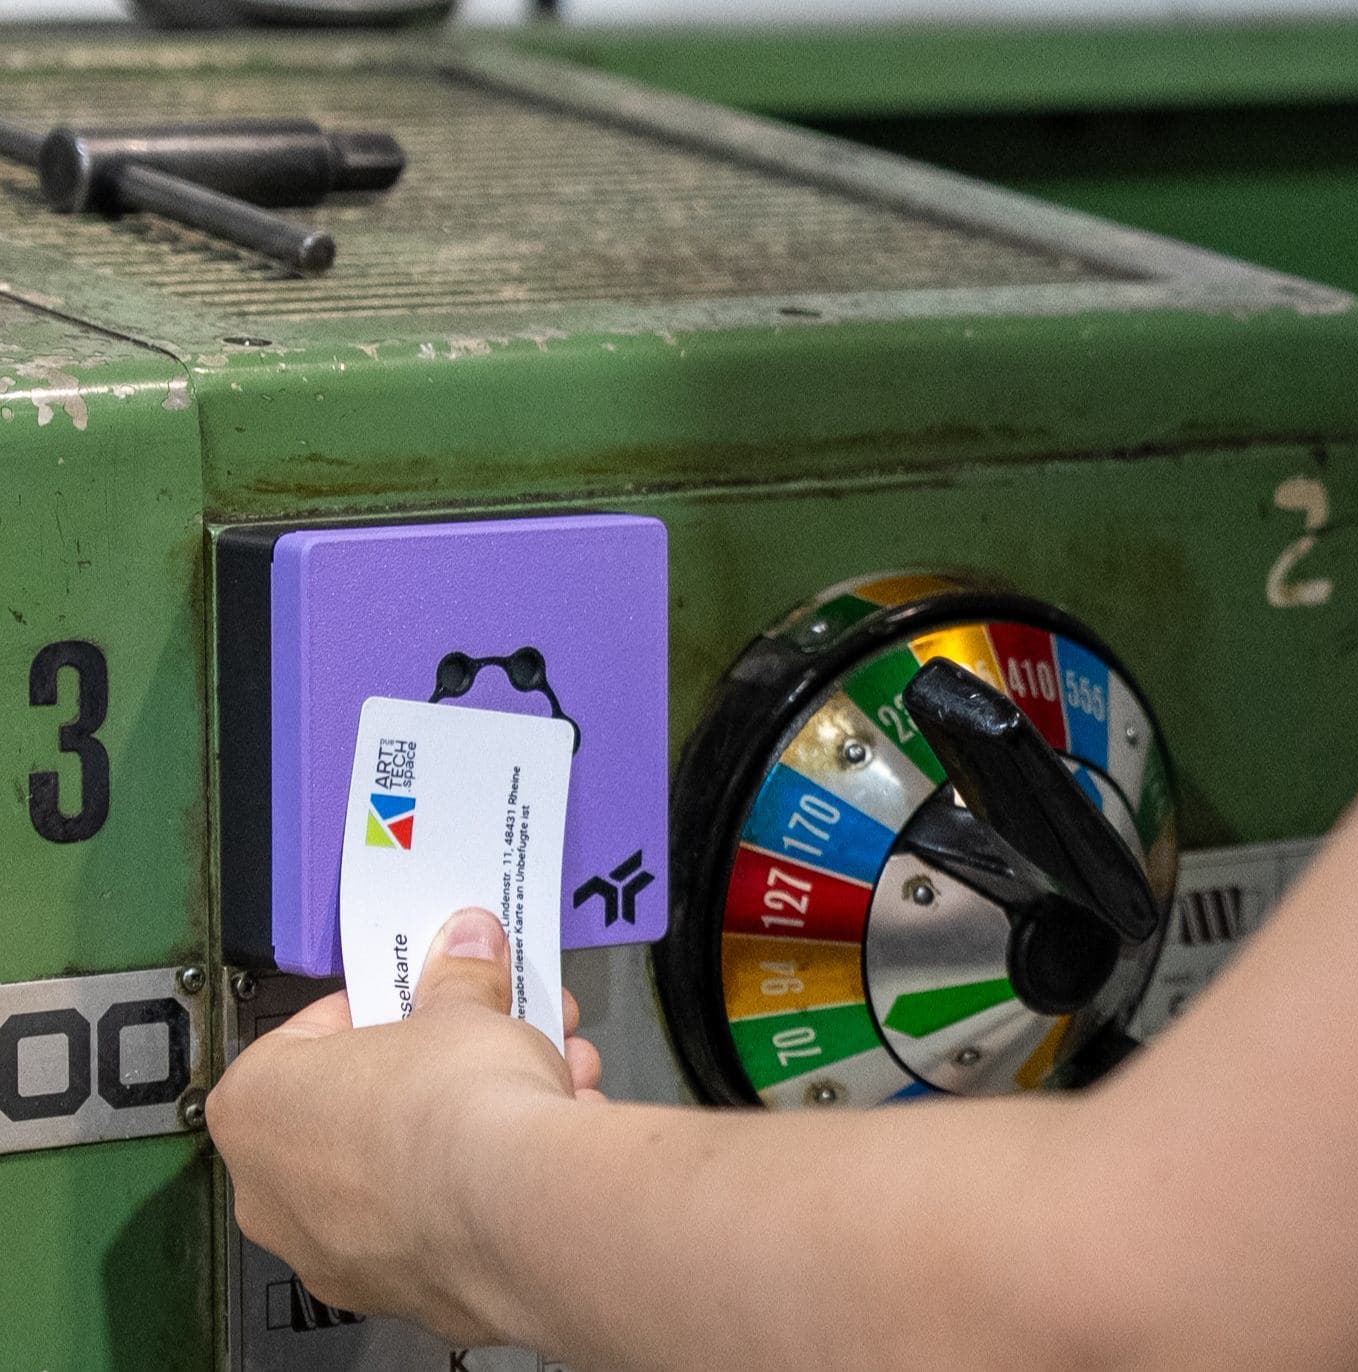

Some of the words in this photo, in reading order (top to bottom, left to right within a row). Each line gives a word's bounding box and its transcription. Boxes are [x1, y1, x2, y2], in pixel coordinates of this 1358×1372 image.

[1266, 477, 1334, 608] 2
[1007, 656, 1057, 702] 410
[28, 640, 110, 844] 3
[375, 746, 393, 790] ART
[389, 740, 408, 791] TECH
[508, 765, 521, 806] Rheine
[504, 809, 516, 846] 48431
[521, 804, 530, 820] ist
[782, 794, 841, 857] 170
[503, 848, 515, 865] 11,
[515, 822, 530, 883] Unbefugte
[501, 869, 512, 928] Lindenstr.
[516, 885, 524, 901] an
[761, 867, 812, 929] 127
[514, 902, 524, 935] Karte
[515, 937, 525, 973] dieser
[771, 1026, 823, 1068] 70
